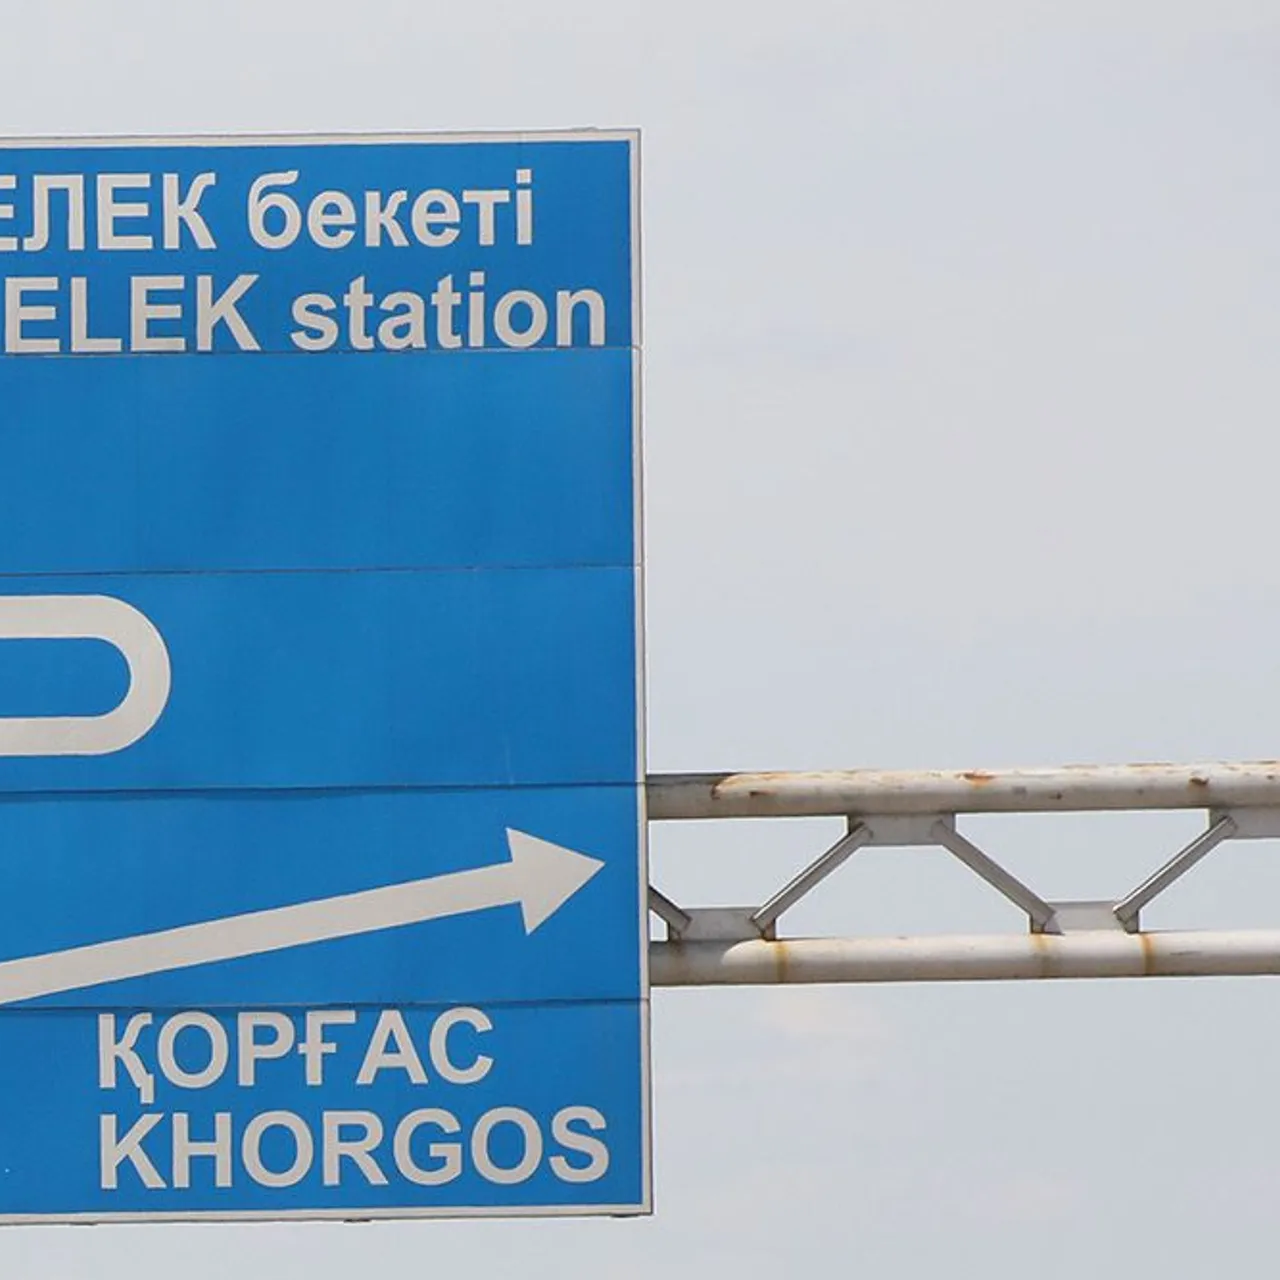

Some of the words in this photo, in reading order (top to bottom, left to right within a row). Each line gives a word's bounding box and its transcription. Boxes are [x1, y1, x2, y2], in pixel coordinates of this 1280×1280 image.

[248, 168, 535, 249] бекеті
[291, 271, 607, 351] station
[98, 1007, 494, 1104] ҚОРҒАС
[99, 1106, 610, 1189] KHORGOS
